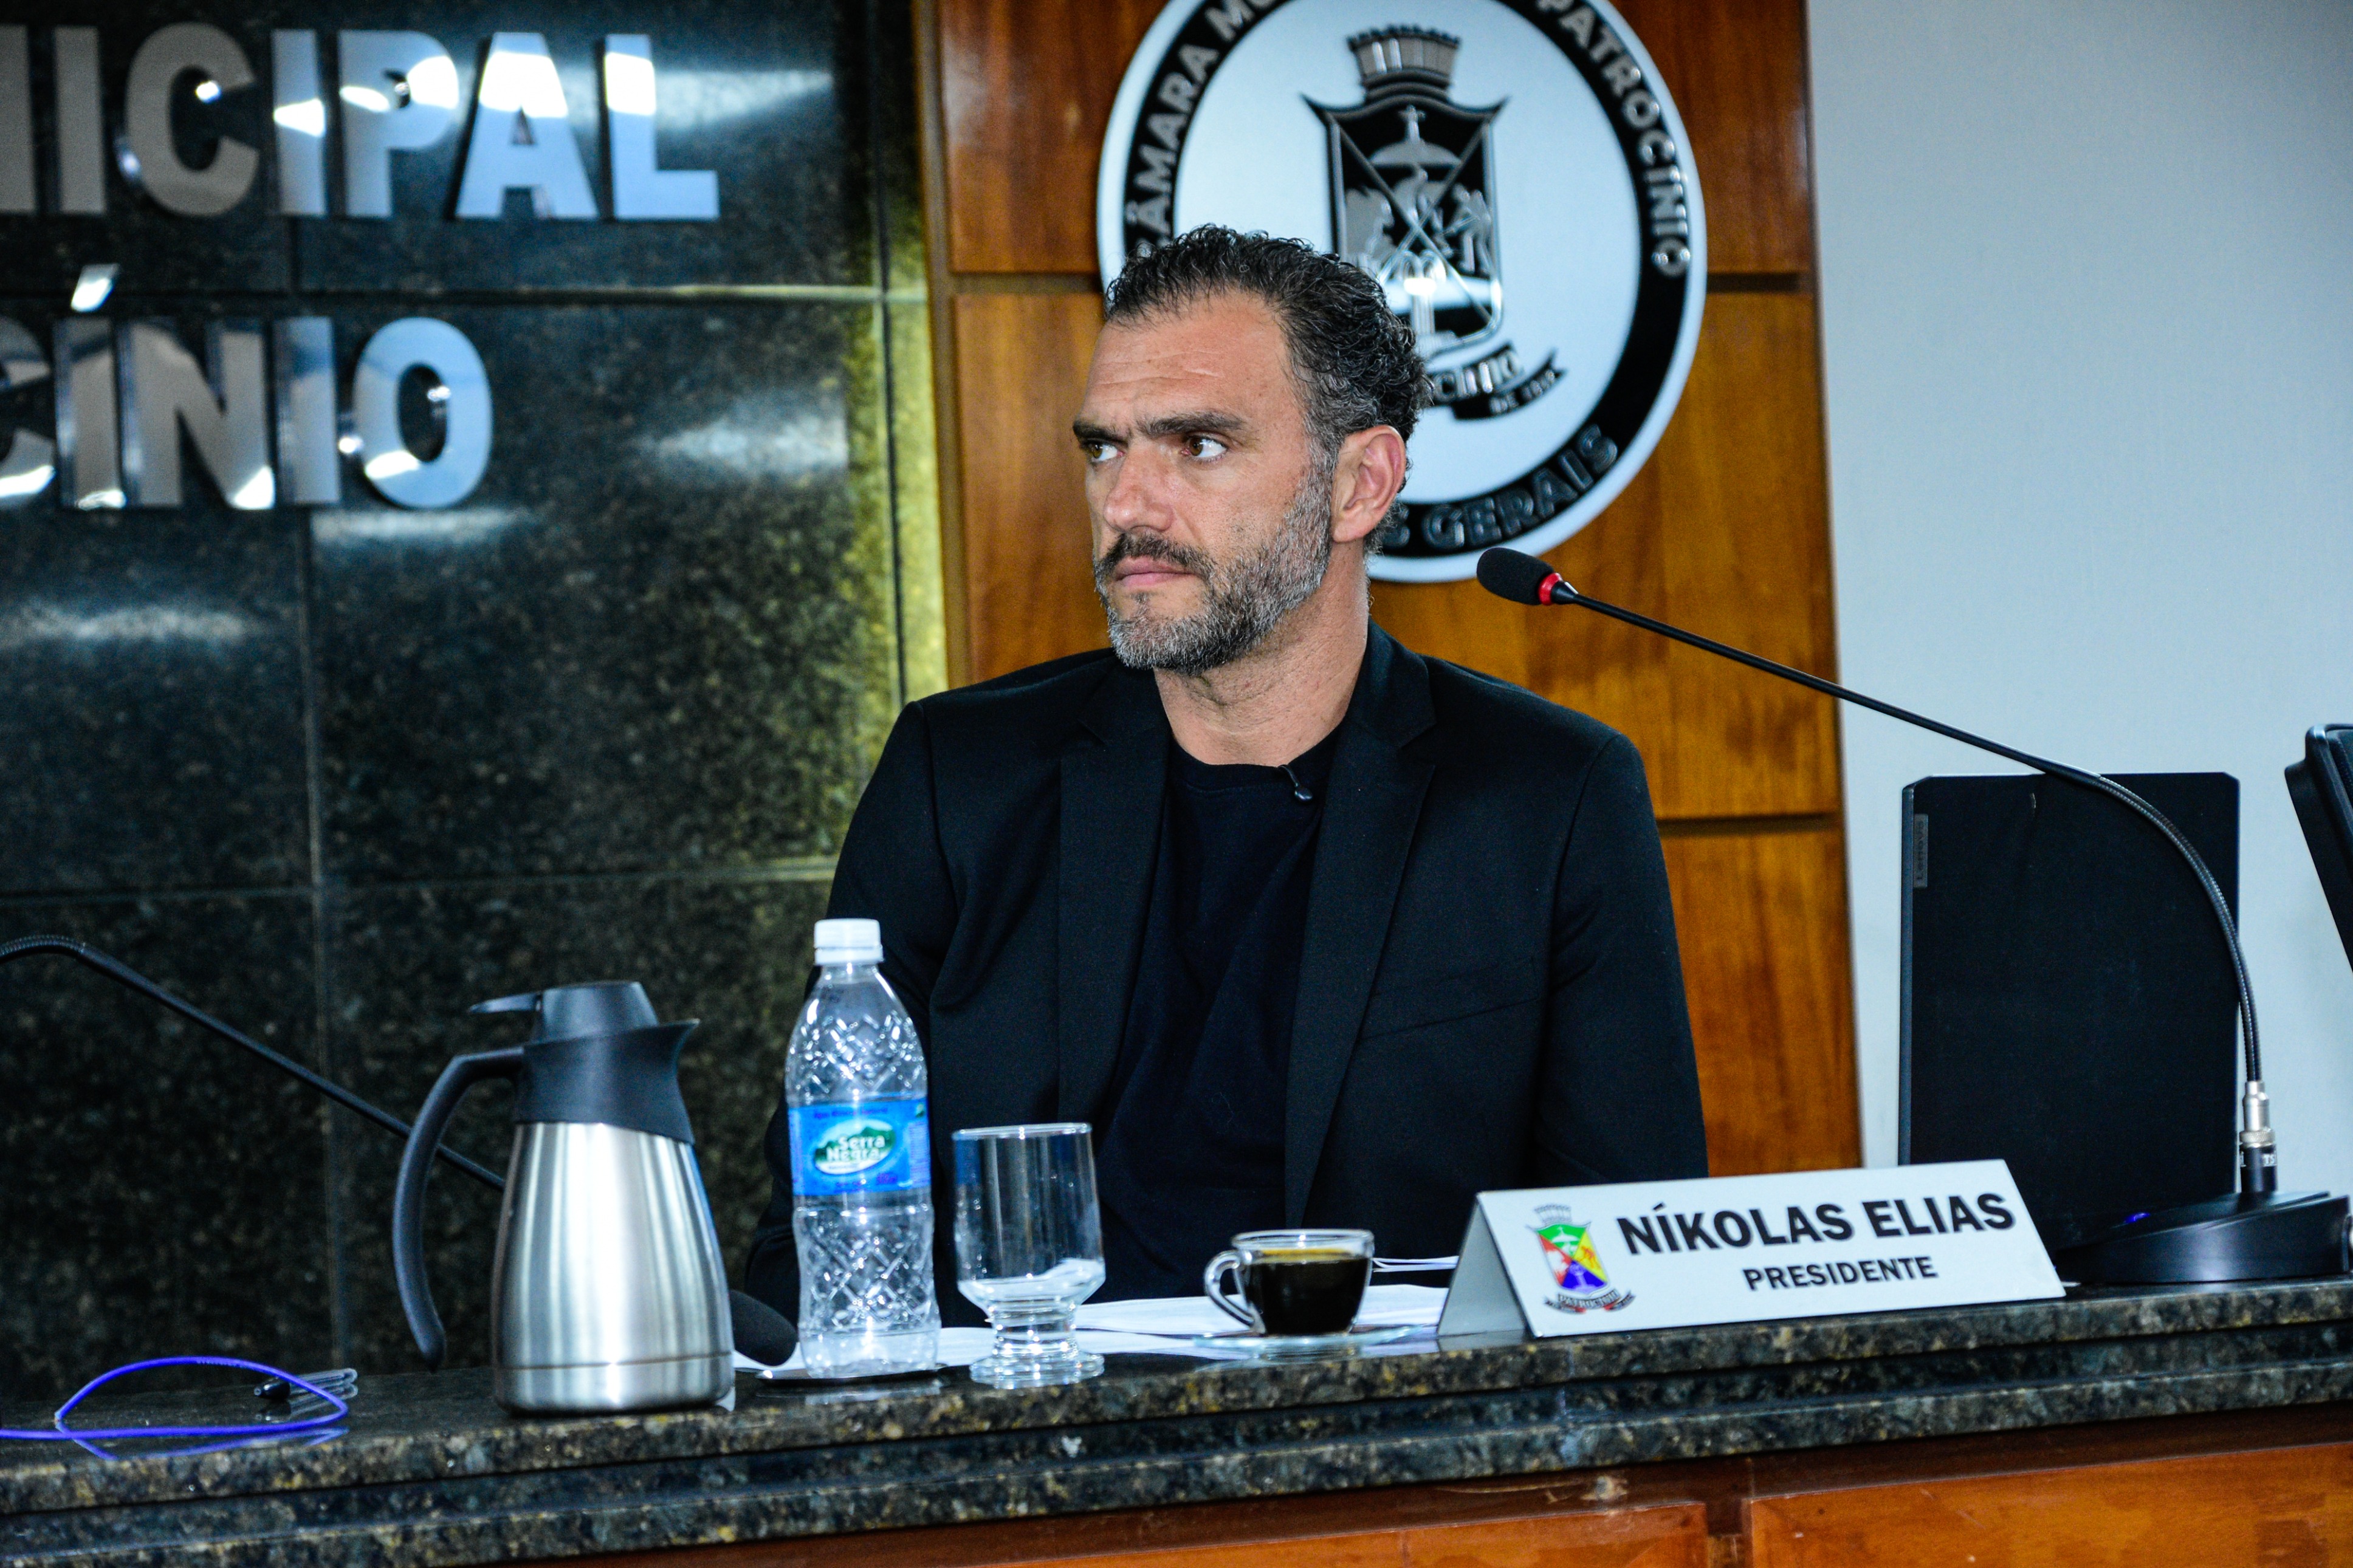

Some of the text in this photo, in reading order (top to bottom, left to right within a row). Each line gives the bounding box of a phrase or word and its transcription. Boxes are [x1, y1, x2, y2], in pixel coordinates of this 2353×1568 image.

[1125, 44, 1220, 257] ÂMARA
[1421, 424, 1618, 547] GERAIS
[826, 1146, 881, 1163] Negra
[838, 1135, 885, 1151] Serra
[1616, 1193, 2016, 1255] NÍKOLAS ELIAS
[1742, 1255, 1939, 1292] PRESIDENTE
